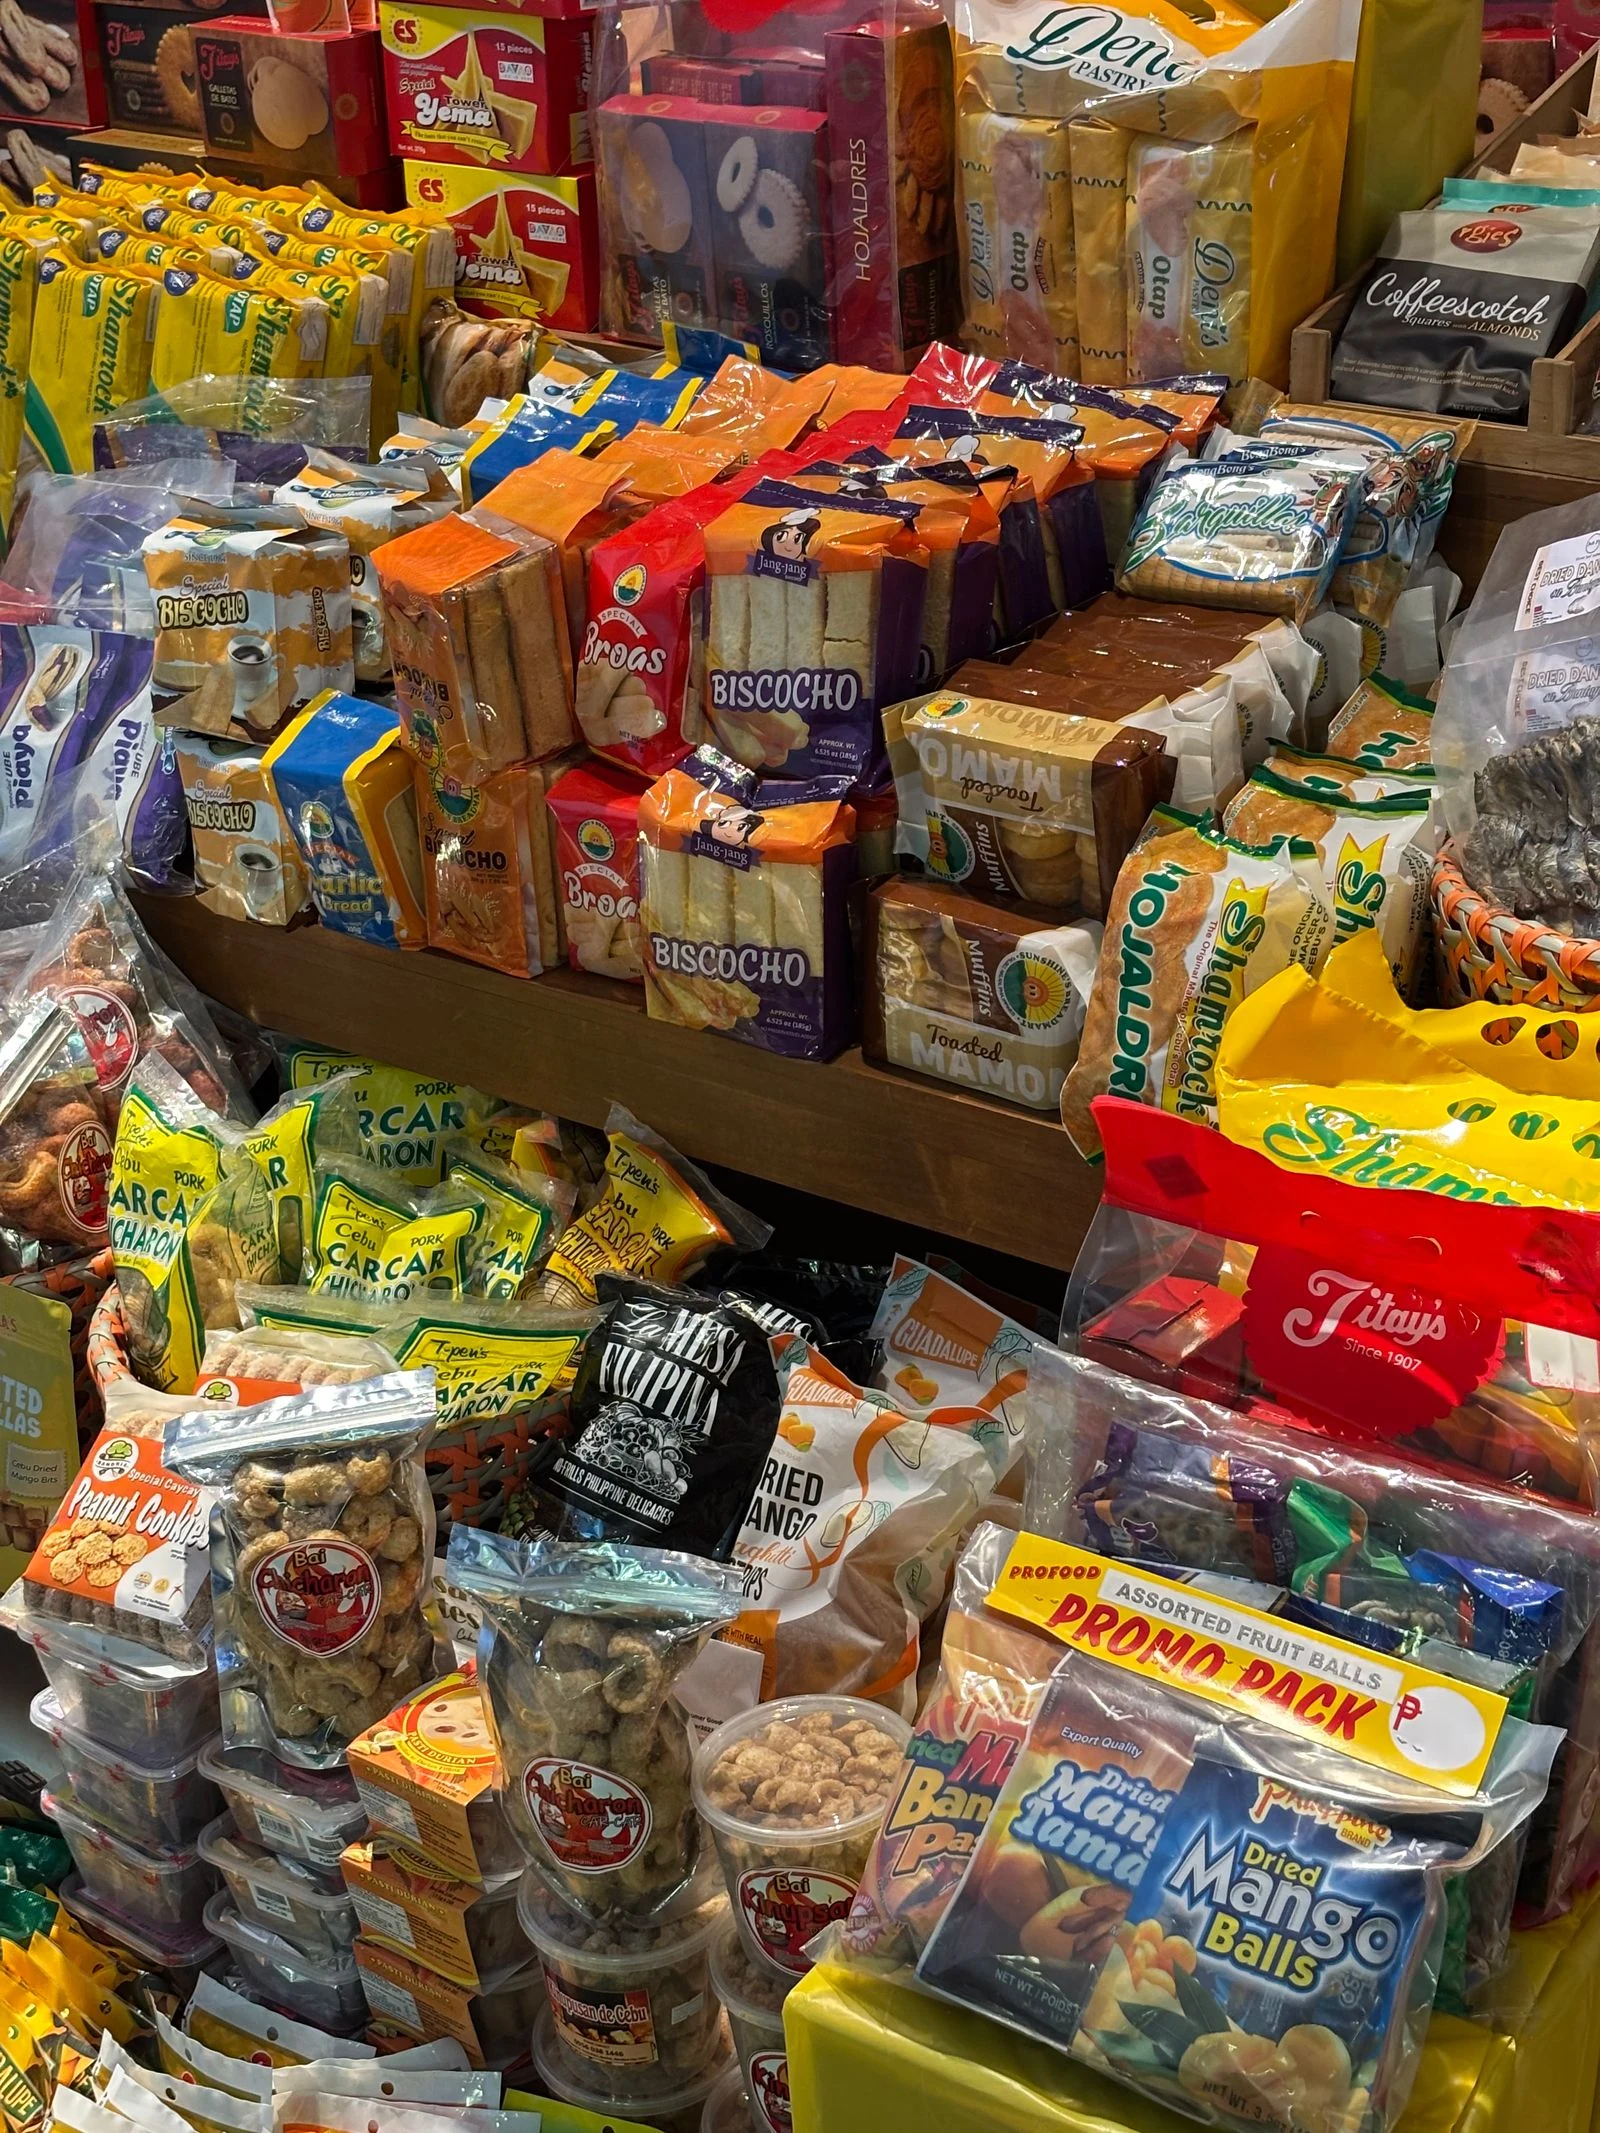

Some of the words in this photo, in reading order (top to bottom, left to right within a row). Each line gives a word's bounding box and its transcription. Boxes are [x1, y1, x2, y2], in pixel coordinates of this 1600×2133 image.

[414, 92, 493, 127] Yema
[855, 138, 873, 281] HOJALDRES
[1011, 231, 1030, 292] Otap
[1148, 255, 1171, 319] Otap
[1366, 272, 1550, 326] Coffeescotch
[1402, 314, 1451, 328] Squares
[1468, 321, 1542, 342] ALMONDS
[180, 575, 230, 600] Special
[1540, 565, 1575, 588] DRIED
[157, 592, 249, 630] BISCOCHO
[312, 587, 332, 652] BISCOCHO
[601, 609, 642, 637] SPECIAL
[583, 621, 667, 674] Broas
[711, 671, 859, 711] BISCOCHO
[1527, 669, 1567, 690] DRIED
[131, 753, 143, 778] UBE
[960, 776, 1044, 813] Toasted
[975, 821, 1010, 892] Muffins
[564, 871, 638, 919] Broa
[578, 866, 627, 890] SPECIAL
[653, 937, 806, 987] BISCOCHO
[965, 939, 993, 1018] Muffins
[1176, 900, 1265, 1117] Shamrock
[926, 1024, 1003, 1063] Toasted
[1174, 1030, 1184, 1061] ebu's
[415, 1082, 457, 1097] PORK
[115, 1146, 141, 1174] Cebu
[615, 1145, 661, 1195] T-pen's
[174, 1170, 206, 1191] PORK
[335, 1222, 377, 1253] Cebu
[410, 1233, 445, 1248] PORK
[326, 1241, 446, 1283] CARCAR
[1283, 1270, 1447, 1348] Titay's
[431, 1337, 490, 1363] T-pen's
[612, 1302, 668, 1339] La
[659, 1308, 747, 1387] MESA
[896, 1318, 978, 1367] GUADALUPE
[1343, 1337, 1383, 1361] Since
[1386, 1350, 1422, 1372] 1907
[599, 1341, 720, 1437] FILIPINA
[33, 1464, 58, 1473] Dried
[128, 1467, 161, 1489] Special
[164, 1480, 200, 1500] Caycay
[760, 1456, 824, 1507] RIED
[68, 1477, 138, 1529] Peanut
[135, 1497, 210, 1552] Cookies
[582, 1470, 628, 1506] PHILIPPINE
[626, 1491, 675, 1526] DELICACIES
[741, 1495, 818, 1541] ANGO
[293, 1548, 327, 1568] Bai
[1009, 1565, 1101, 1581] PROFOOD
[745, 1633, 762, 1646] REAL
[1114, 1582, 1234, 1635] ASSORTED
[1235, 1624, 1306, 1659] FRUIT
[1307, 1651, 1384, 1691] BALLS
[1044, 1592, 1226, 1685] PROMO
[1232, 1657, 1379, 1741] PACK
[407, 1732, 431, 1758] PASTI
[428, 1749, 477, 1765] DURIAN
[1060, 1726, 1098, 1746] Export
[1101, 1735, 1143, 1759] Quality
[558, 1767, 592, 1789] Bai
[1101, 1767, 1168, 1815] Dried
[580, 1813, 642, 1830] CAR-CAR
[1340, 1828, 1371, 1848] BRAND
[1244, 1841, 1322, 1888] Dried
[775, 1875, 810, 1894] Bai
[1169, 1835, 1399, 1966] Mango
[1203, 1911, 1320, 1988] Balls
[994, 1967, 1013, 1985] NET
[599, 2004, 615, 2023] de
[614, 2005, 648, 2024] Cebu
[1203, 2079, 1229, 2098] NET
[1228, 2091, 1250, 2115] WT.
